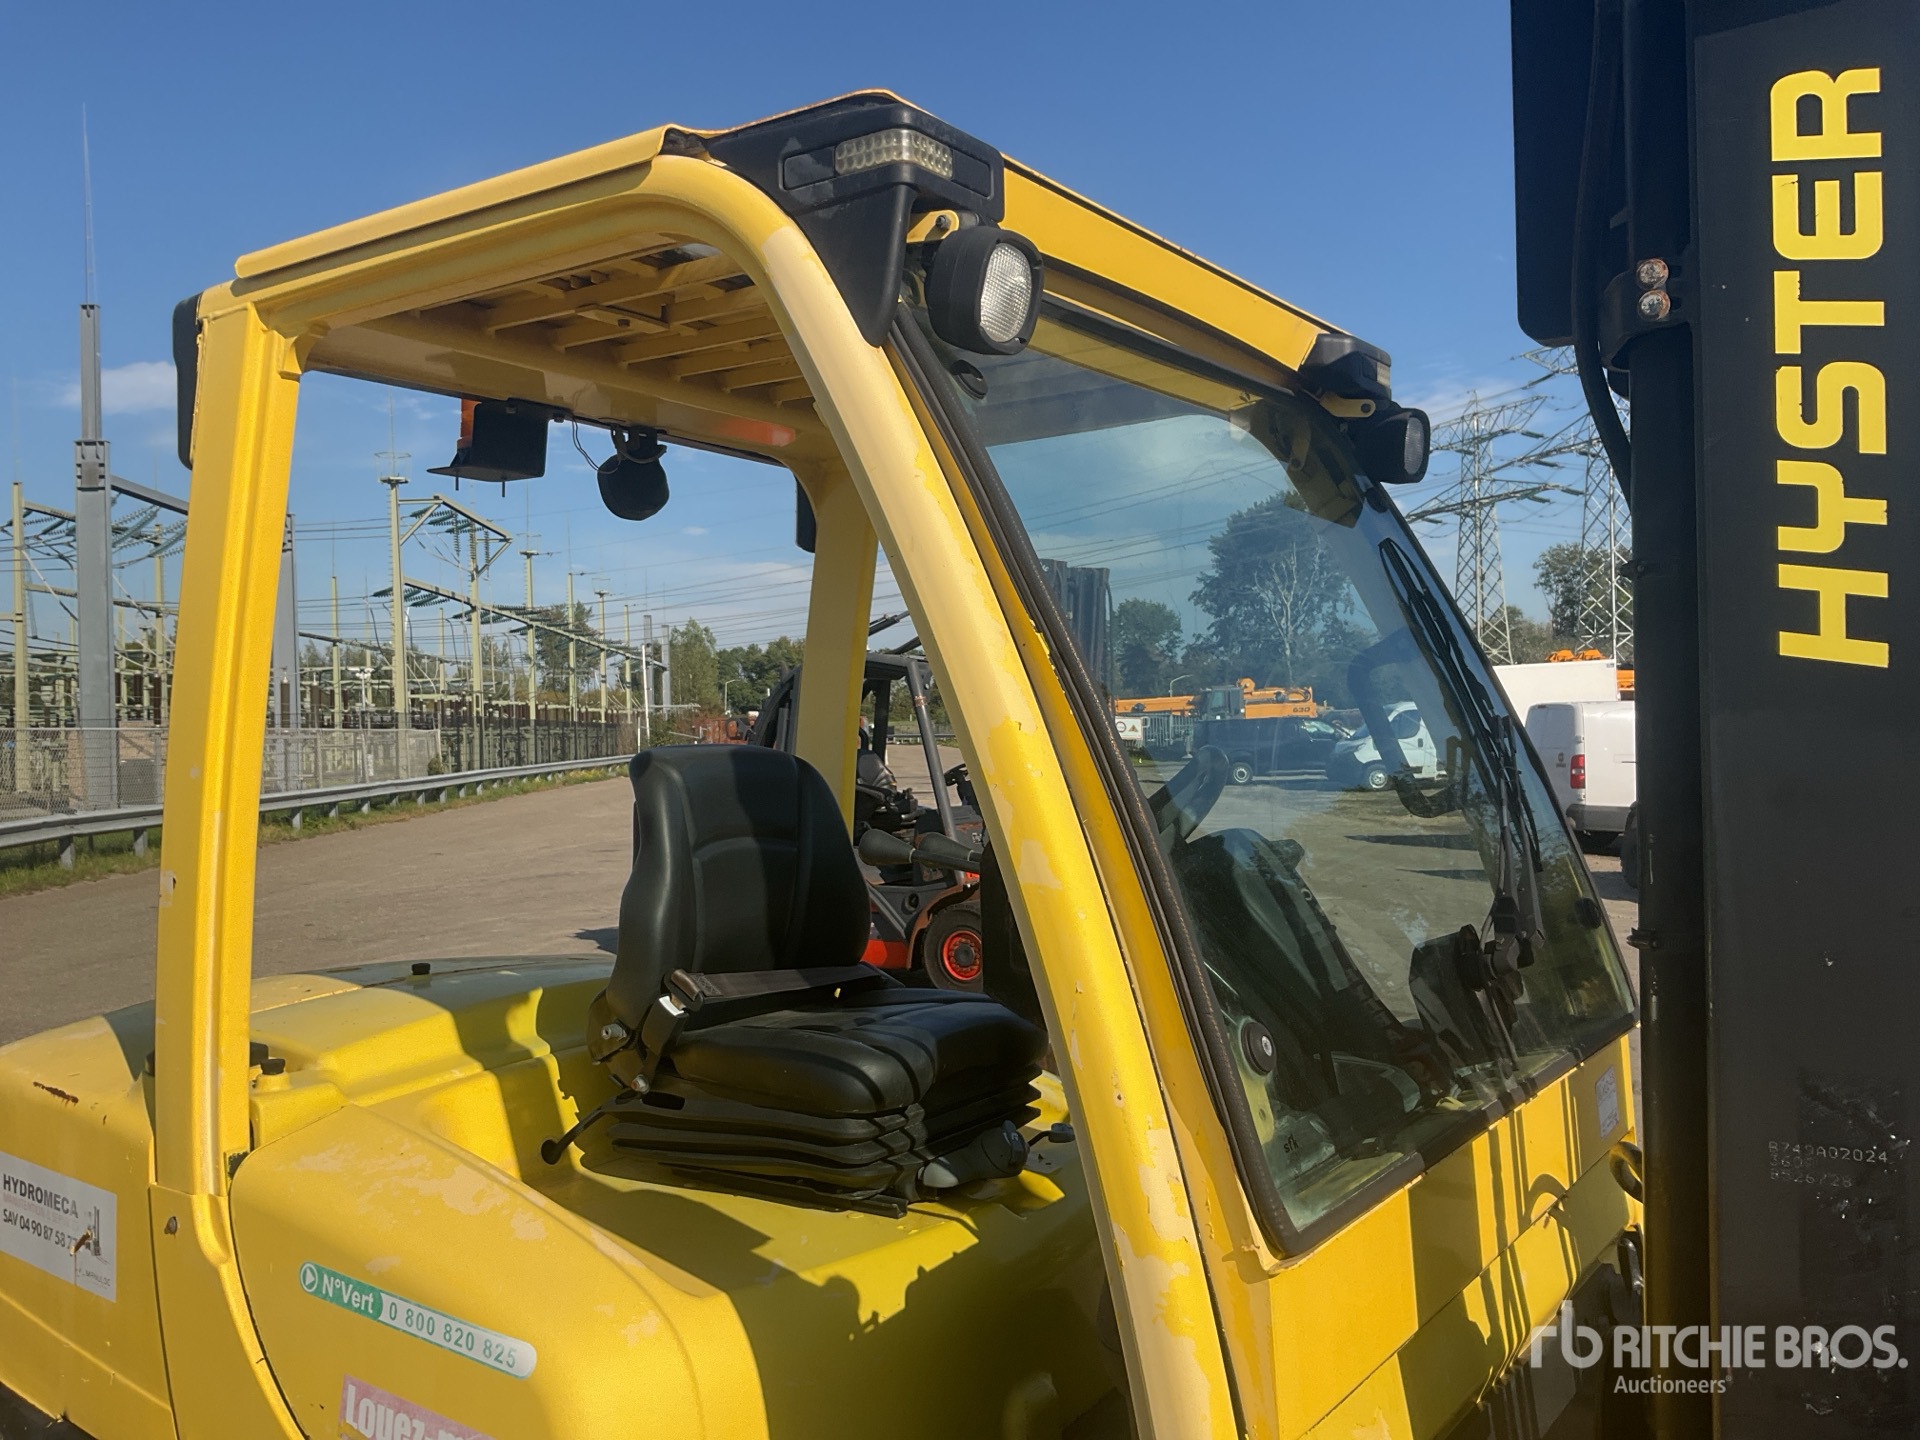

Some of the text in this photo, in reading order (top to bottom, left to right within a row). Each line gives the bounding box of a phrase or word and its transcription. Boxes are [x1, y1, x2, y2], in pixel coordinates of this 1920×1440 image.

[1770, 67, 1889, 668] HYSTER
[3, 1173, 79, 1219] HYDROMECA
[3, 1208, 19, 1226] SAV
[19, 1215, 30, 1232] 04
[32, 1220, 42, 1237] 90
[43, 1225, 53, 1241] 87
[55, 1230, 65, 1248] 58
[389, 1302, 397, 1321] 0
[405, 1308, 435, 1336] 800
[443, 1323, 475, 1351] 820
[483, 1338, 517, 1369] 825
